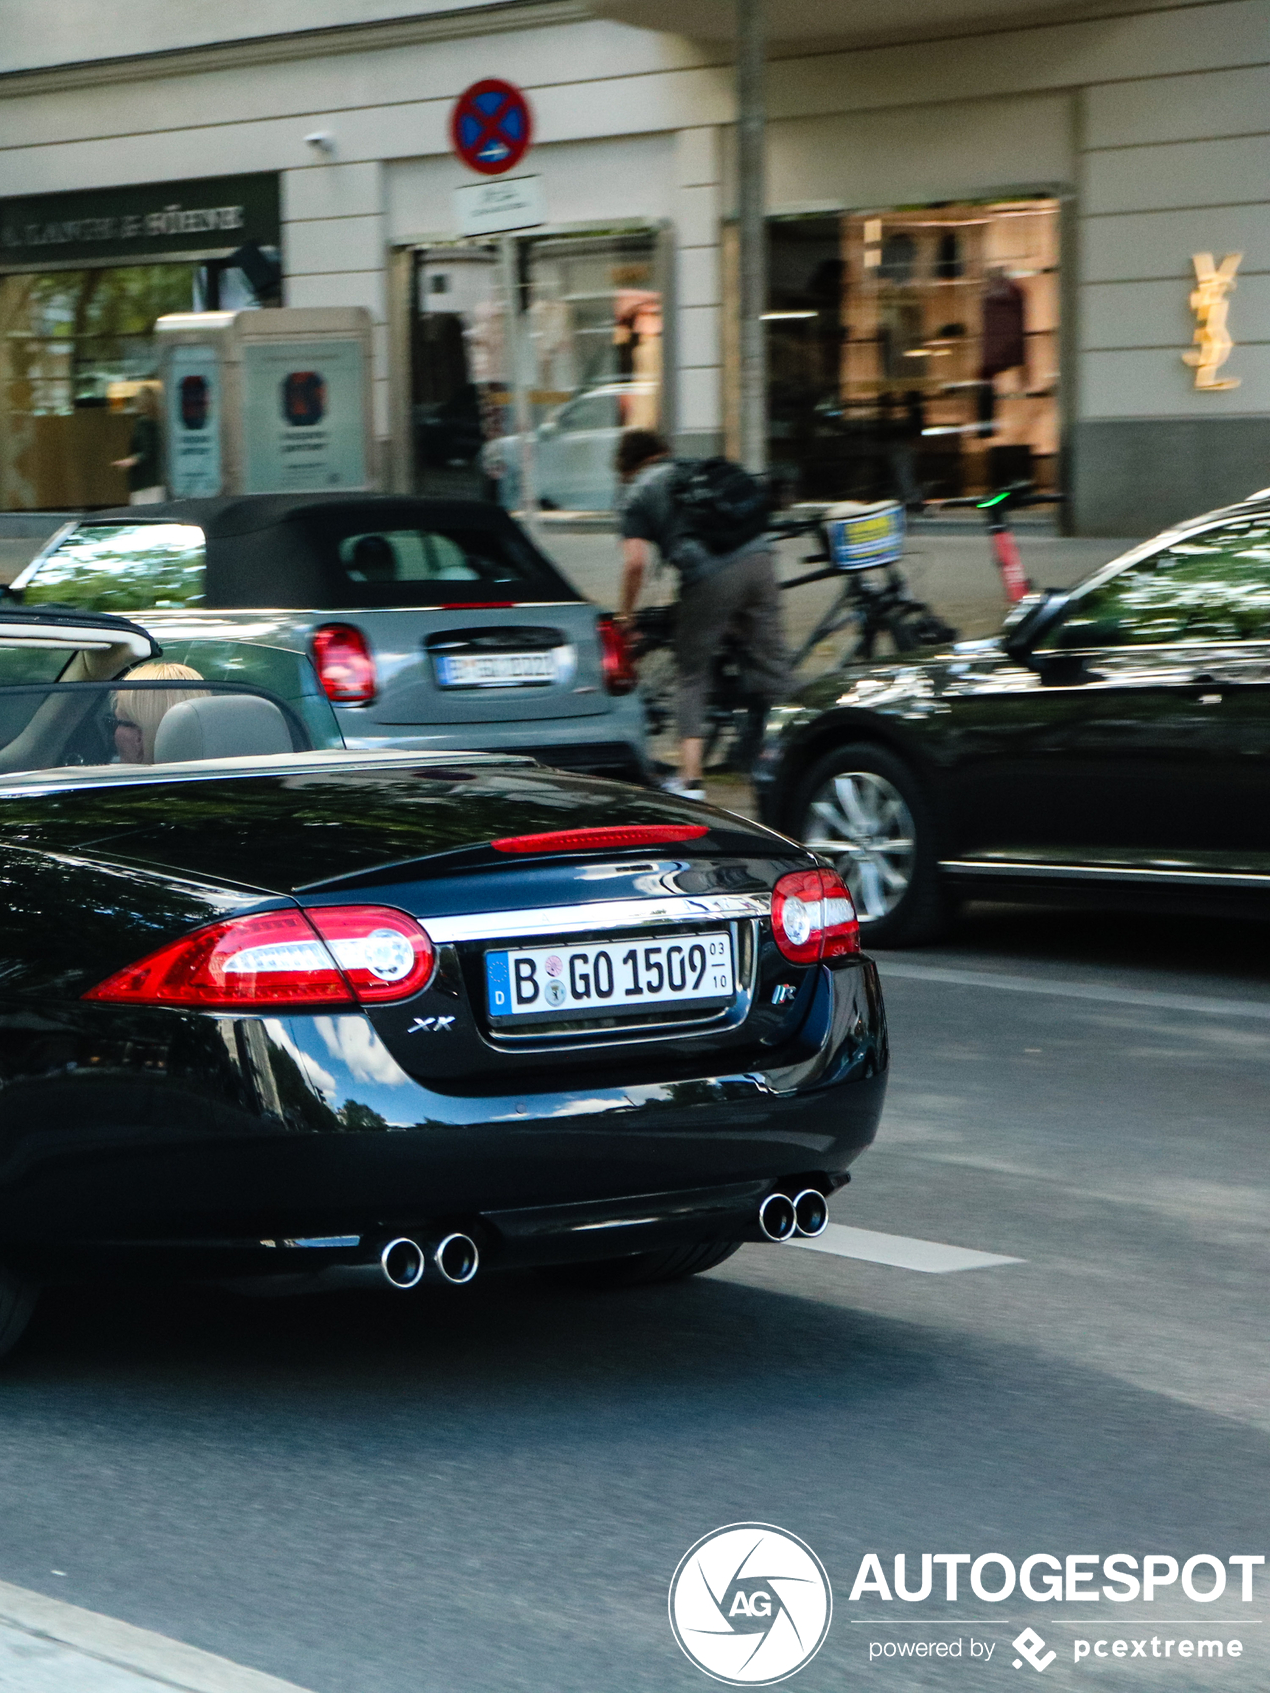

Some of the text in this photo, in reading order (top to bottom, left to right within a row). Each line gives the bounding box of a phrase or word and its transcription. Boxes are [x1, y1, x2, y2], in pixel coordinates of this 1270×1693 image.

[709, 942, 725, 956] 03
[514, 944, 706, 1005] B GO 1509
[713, 975, 727, 988] 10
[495, 990, 505, 1005] D
[407, 1016, 456, 1033] XK
